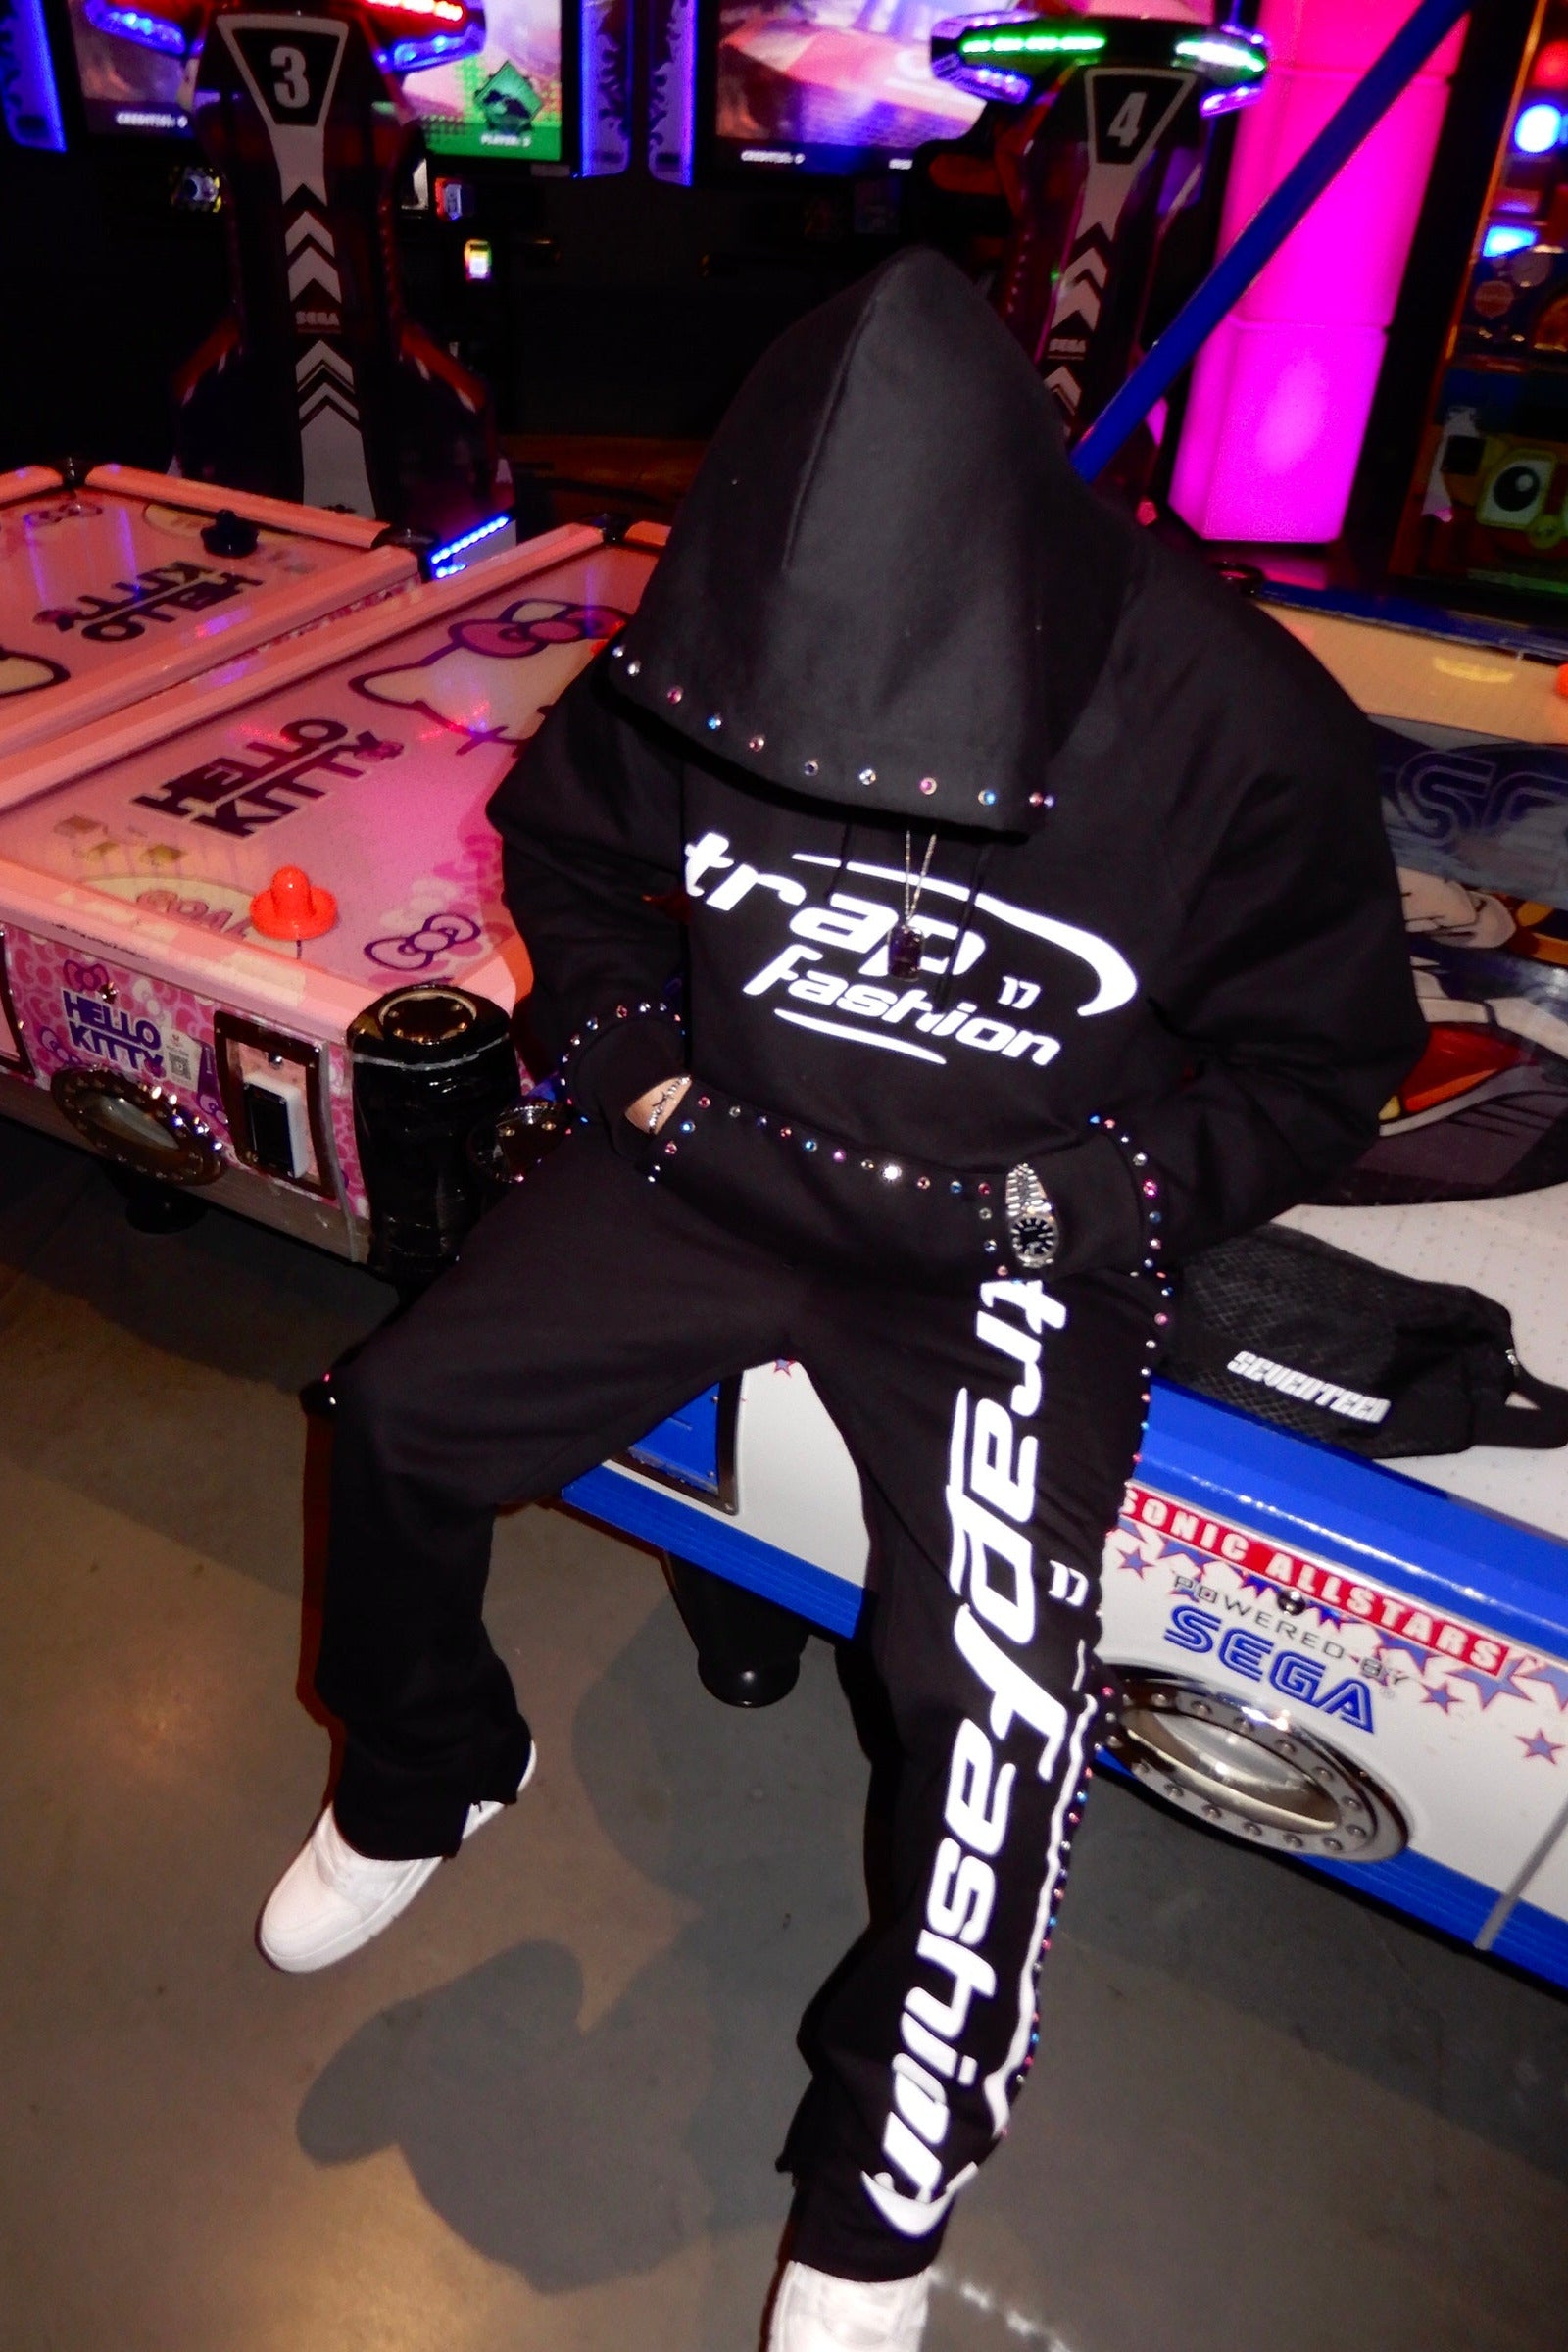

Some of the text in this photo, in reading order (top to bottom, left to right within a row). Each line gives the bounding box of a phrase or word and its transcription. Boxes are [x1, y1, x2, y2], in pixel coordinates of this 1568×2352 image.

[270, 45, 310, 108] 3
[1106, 91, 1147, 148] 4
[296, 310, 341, 325] SEGA
[41, 561, 214, 632] KITTY
[81, 572, 264, 642] HELLO
[132, 719, 348, 817] HELLO
[191, 730, 403, 838] KITTY
[685, 832, 986, 977] trap
[63, 989, 162, 1051] HELLO
[743, 942, 1061, 1066] fashion
[997, 975, 1041, 1010] 17
[68, 1021, 165, 1078] KITTY
[947, 1278, 1067, 1644] trap
[1122, 1489, 1501, 1670] SONIC ALLSTARS
[1163, 1603, 1375, 1734] SEGA
[1174, 1573, 1410, 1685] POWERED BY
